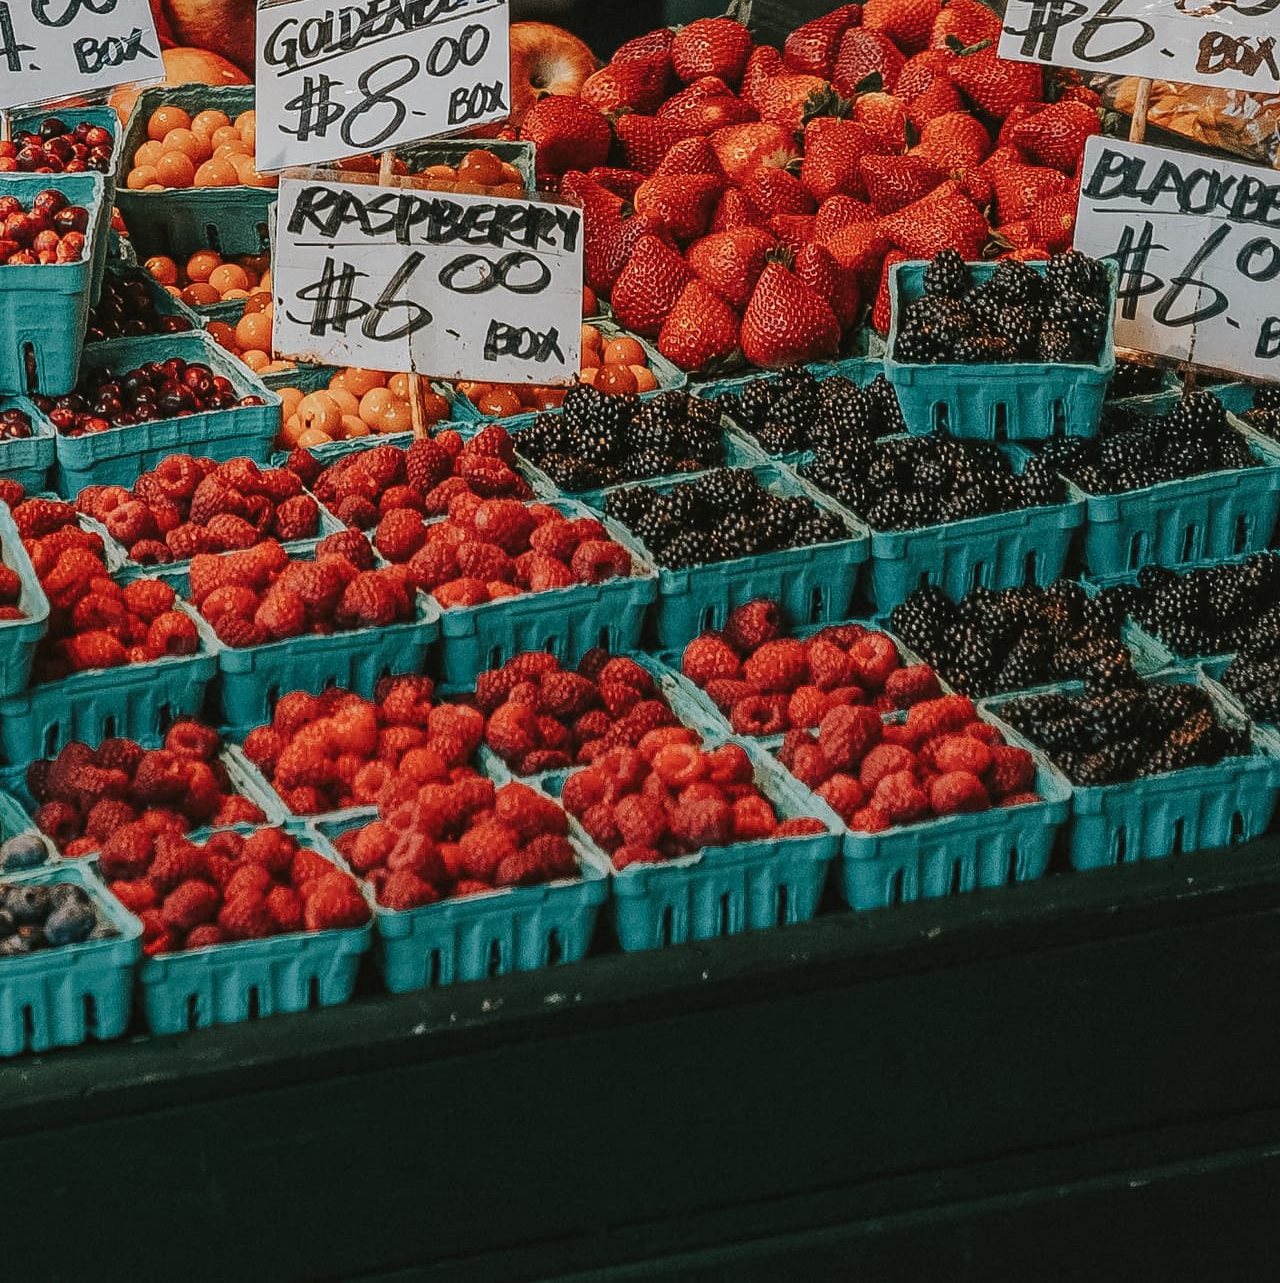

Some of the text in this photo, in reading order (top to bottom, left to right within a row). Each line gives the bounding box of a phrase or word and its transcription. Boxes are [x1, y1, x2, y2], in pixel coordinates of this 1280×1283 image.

[74, 27, 159, 74] BOX
[1195, 31, 1280, 81] BOX
[278, 24, 508, 148] $8.00 BOX
[287, 186, 581, 252] RASPBERRY
[286, 251, 565, 364] $6.00 BOX
